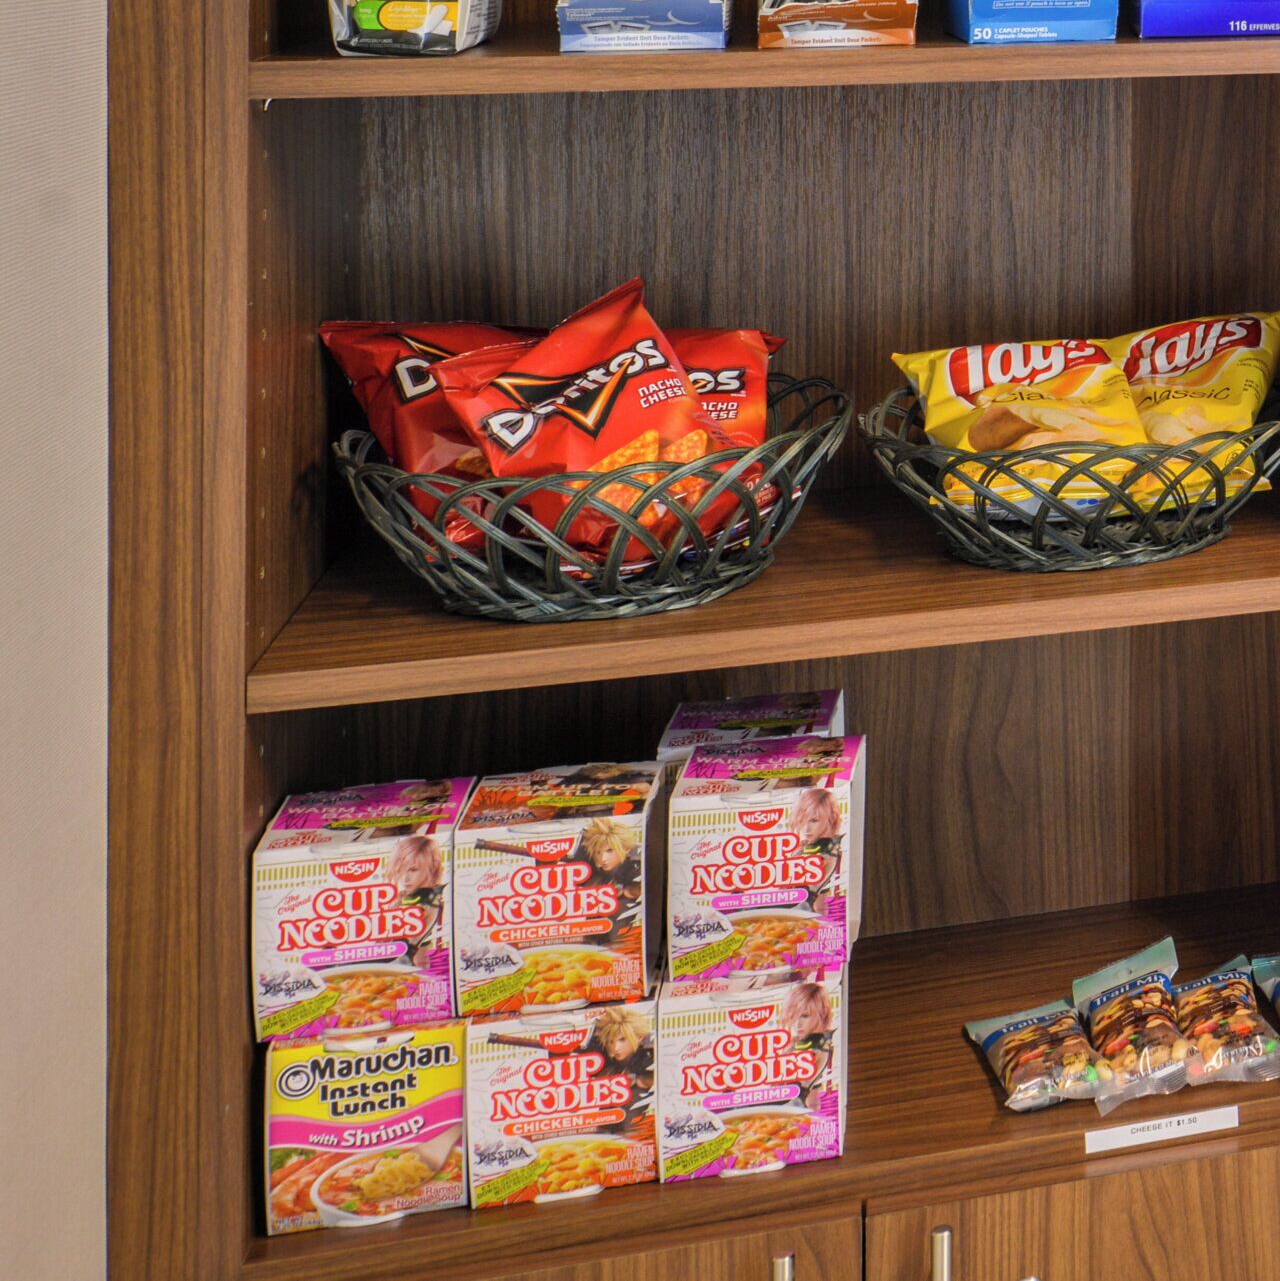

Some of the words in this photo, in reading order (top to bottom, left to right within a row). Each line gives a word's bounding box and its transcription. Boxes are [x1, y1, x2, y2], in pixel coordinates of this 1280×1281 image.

[973, 28, 991, 39] 50
[1229, 21, 1247, 31] 116
[638, 379, 681, 398] NACHO
[640, 386, 688, 409] CHEESE
[742, 811, 779, 825] NISSIN
[530, 840, 572, 855] NISSIN
[723, 833, 800, 864] CUP
[334, 861, 377, 875] NISSIN
[509, 863, 592, 893] CUP
[690, 854, 824, 894] NOODLES
[314, 885, 397, 919] CUP
[476, 885, 620, 928] NOODLES
[741, 889, 799, 904] SHRIMP
[278, 907, 426, 951] NOODLES
[498, 925, 570, 942] CHICKEN
[333, 943, 398, 961] SHRIMP
[732, 1009, 771, 1023] NISSIN
[544, 1031, 585, 1045] NISSIN
[712, 1029, 791, 1063] CUP
[310, 1045, 454, 1081] Maruchan
[523, 1055, 604, 1085] CUP
[680, 1052, 817, 1095] NOODLES
[320, 1072, 417, 1103] Instant
[489, 1077, 630, 1121] NOODLES
[732, 1087, 791, 1105] SHRIMP
[330, 1095, 407, 1119] Lunch
[308, 1132, 339, 1146] with
[342, 1115, 425, 1148] Shrimp
[512, 1115, 585, 1135] CHICKEN
[1130, 1123, 1163, 1136] CHEESE
[1165, 1122, 1173, 1130] IT
[1177, 1116, 1198, 1127] $1.50
